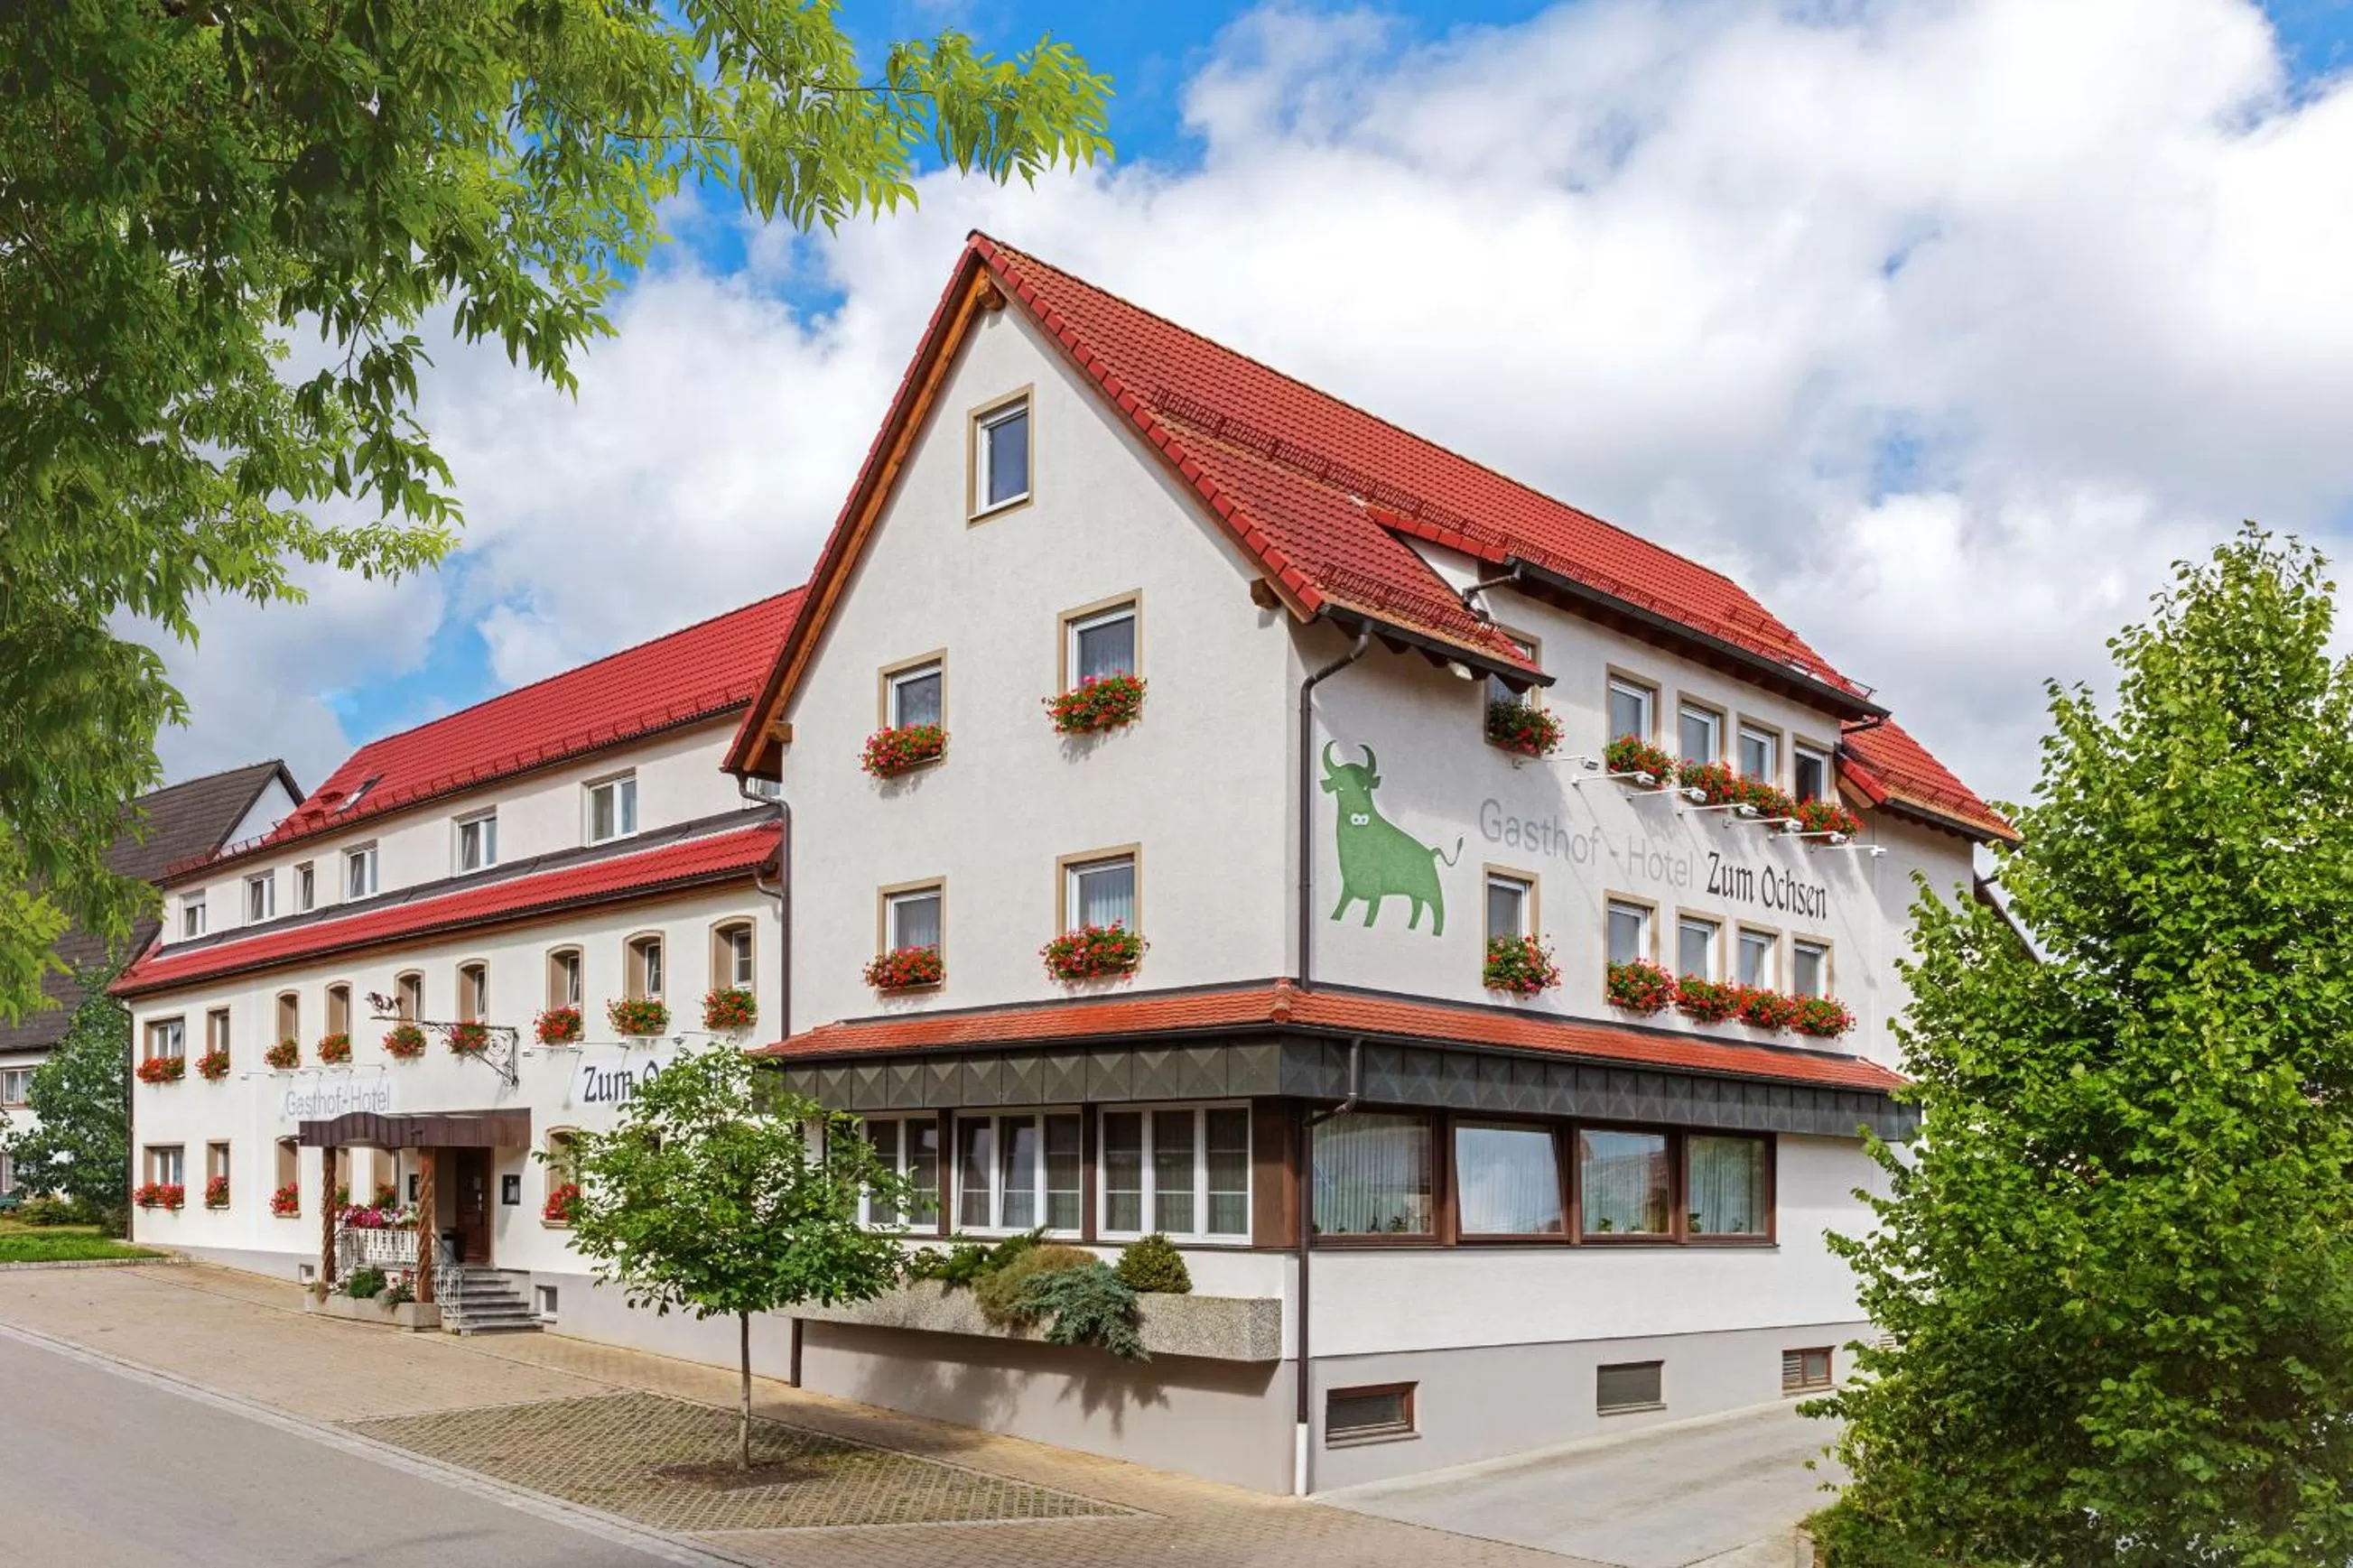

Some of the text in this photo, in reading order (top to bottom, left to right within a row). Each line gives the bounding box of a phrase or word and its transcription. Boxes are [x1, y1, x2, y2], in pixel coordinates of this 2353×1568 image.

[1480, 798, 1601, 866] Gasthof
[1627, 835, 1694, 888] Hotel
[1707, 850, 1754, 904] Zum
[1762, 865, 1827, 920] Ochsen
[584, 1066, 634, 1102] Zum
